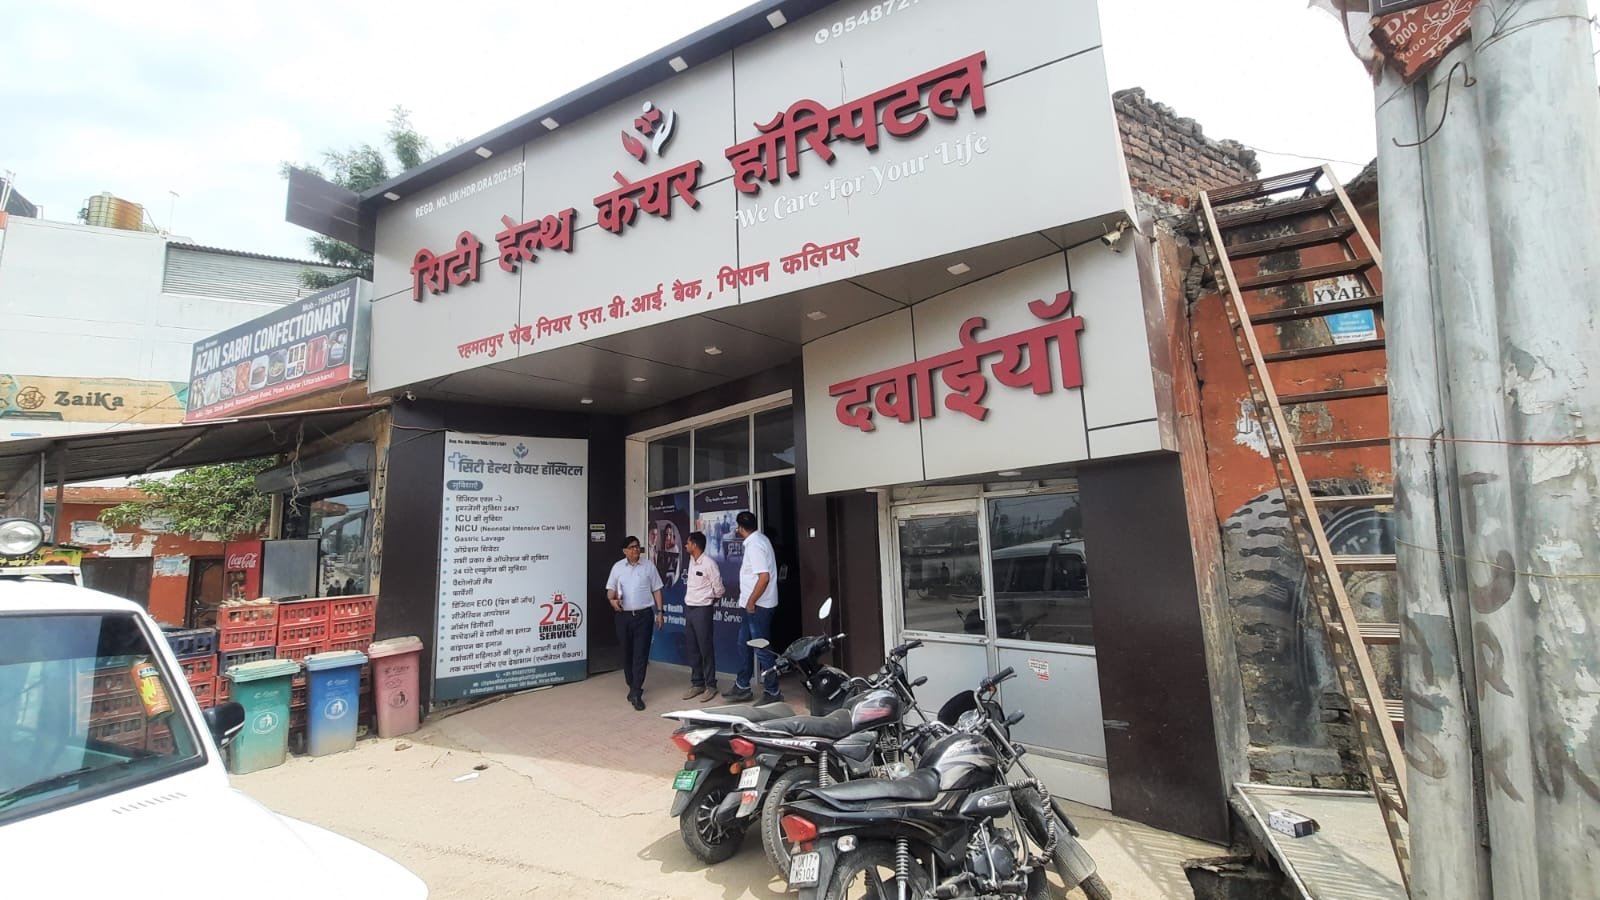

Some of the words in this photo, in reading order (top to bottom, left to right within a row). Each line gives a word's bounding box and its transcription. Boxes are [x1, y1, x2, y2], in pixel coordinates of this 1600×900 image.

[831, 0, 919, 38] 9548727
[411, 231, 482, 301] सिटी
[496, 208, 577, 273] हेल्थ
[594, 160, 703, 234] केयर
[725, 50, 986, 195] हॉस्पिटल
[735, 204, 768, 228] We
[774, 191, 819, 219] Care
[824, 175, 865, 200] For
[869, 154, 929, 195] Your
[935, 132, 991, 167] Life
[415, 202, 434, 219] REGD.
[437, 196, 448, 209] NO.
[457, 333, 505, 358] रहमतपुर
[717, 262, 770, 292] पिरान
[780, 237, 860, 275] कलियर
[195, 345, 222, 377] AZAN
[221, 334, 253, 366] SABRI
[253, 297, 351, 354] CONFECTIONARY
[459, 459, 485, 473] सिटी
[487, 460, 512, 474] हेल्थ
[514, 461, 542, 475] केयर
[539, 603, 571, 626] 24
[668, 614, 687, 626] Priority
[539, 623, 577, 633] EMERGENCY
[539, 630, 577, 640] SERVICE
